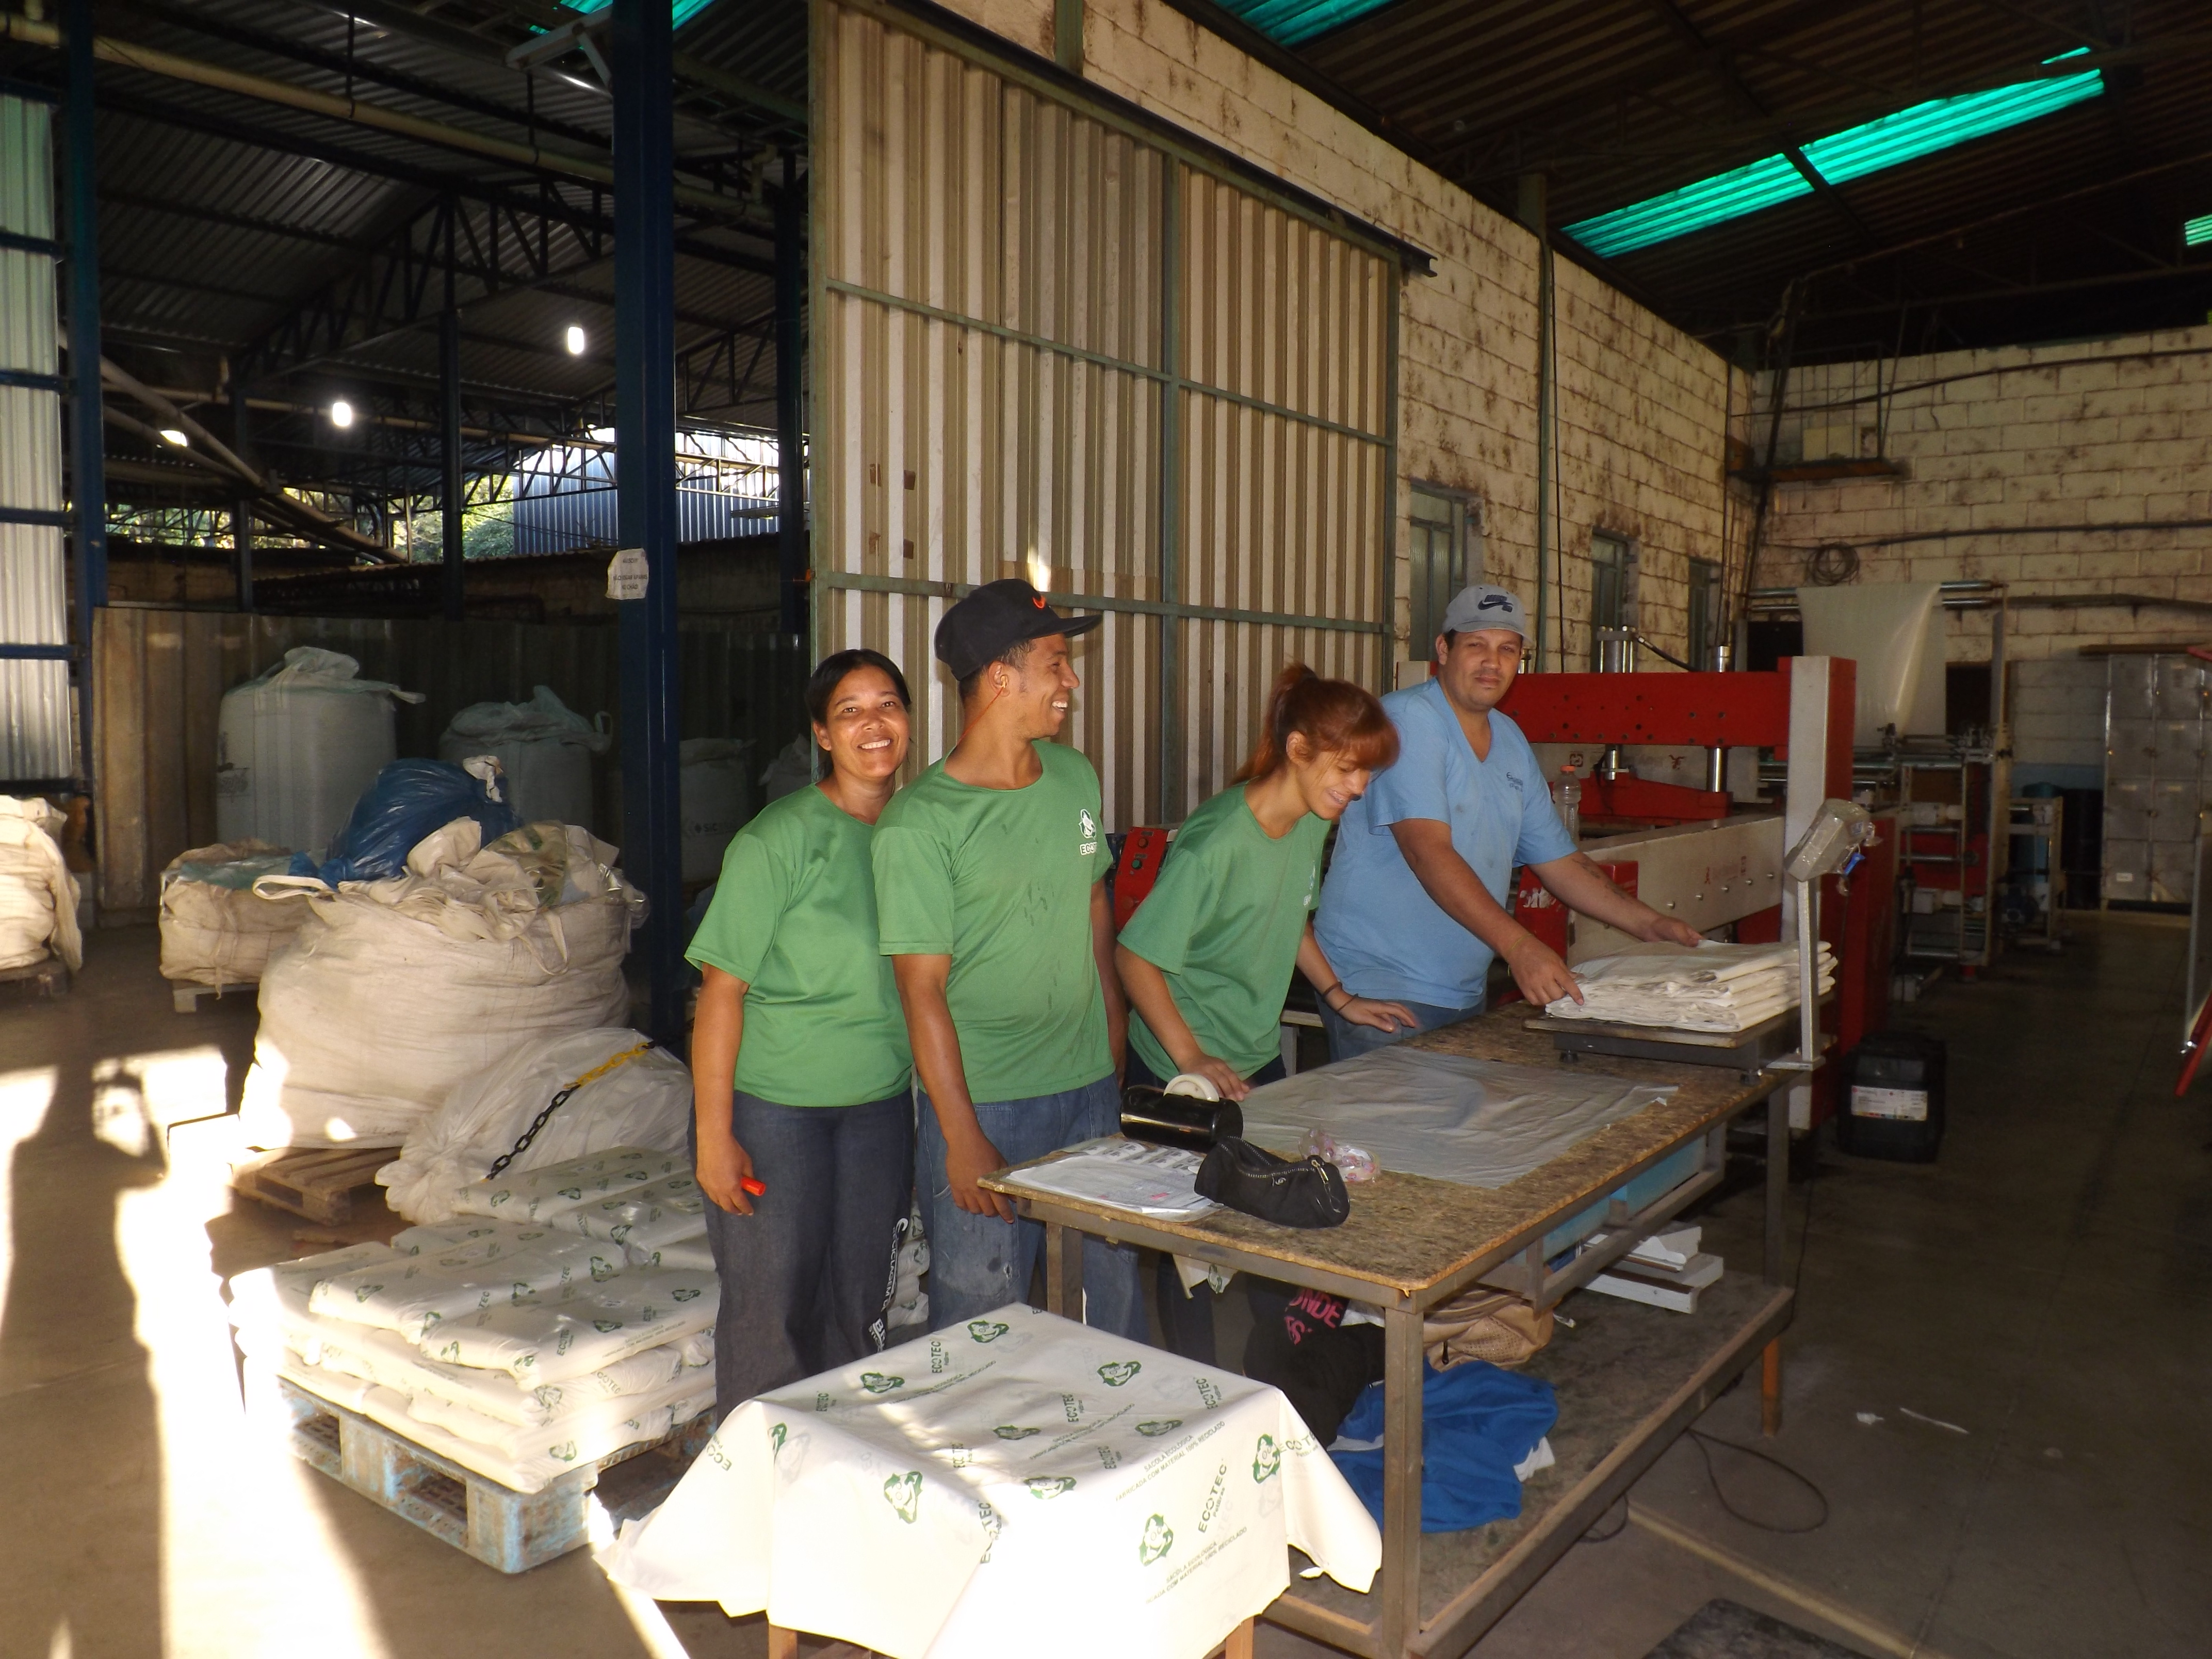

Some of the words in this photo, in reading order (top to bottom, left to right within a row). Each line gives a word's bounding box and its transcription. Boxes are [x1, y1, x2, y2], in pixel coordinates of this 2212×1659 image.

[931, 1341, 942, 1373] ECOTEC
[1062, 1393, 1079, 1422] ECOTEC
[1196, 1378, 1218, 1409] ECOTEC
[1144, 1454, 1166, 1472] SACOLA
[1147, 1469, 1160, 1481] COM
[1160, 1450, 1186, 1472] MATERIAL
[1185, 1441, 1199, 1453] 100%
[1198, 1421, 1226, 1444] RECICLADO
[1198, 1464, 1227, 1534] ECOTEC
[1166, 1579, 1179, 1591] COM
[1218, 1526, 1247, 1552] RECICLADO
[1166, 1565, 1188, 1584] SACOLA
